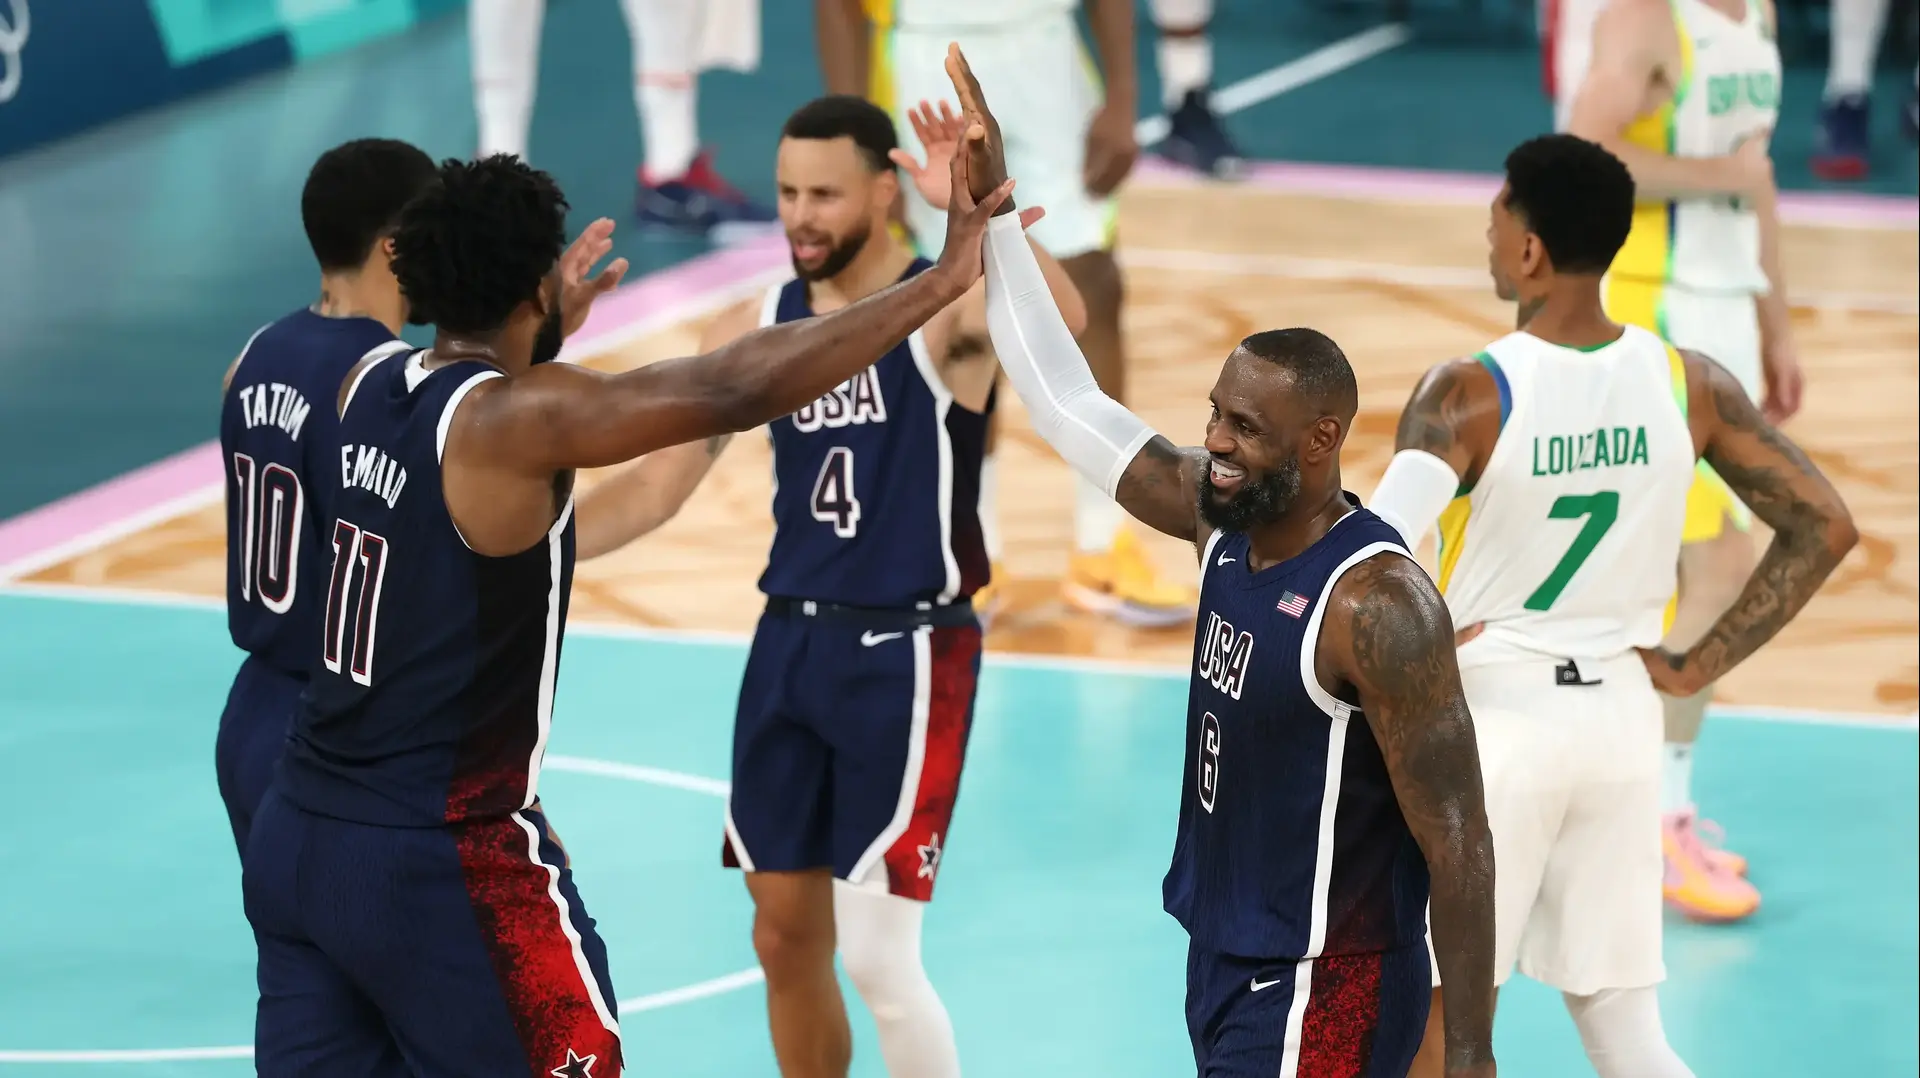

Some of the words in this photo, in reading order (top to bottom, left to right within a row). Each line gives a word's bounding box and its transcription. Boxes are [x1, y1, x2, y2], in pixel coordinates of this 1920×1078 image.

[239, 383, 311, 442] TATUM
[234, 452, 303, 614] 10
[811, 447, 861, 538] 4
[323, 517, 389, 687] 11
[1523, 490, 1620, 611] 7
[1199, 611, 1254, 700] USA
[1198, 711, 1221, 814] 6
